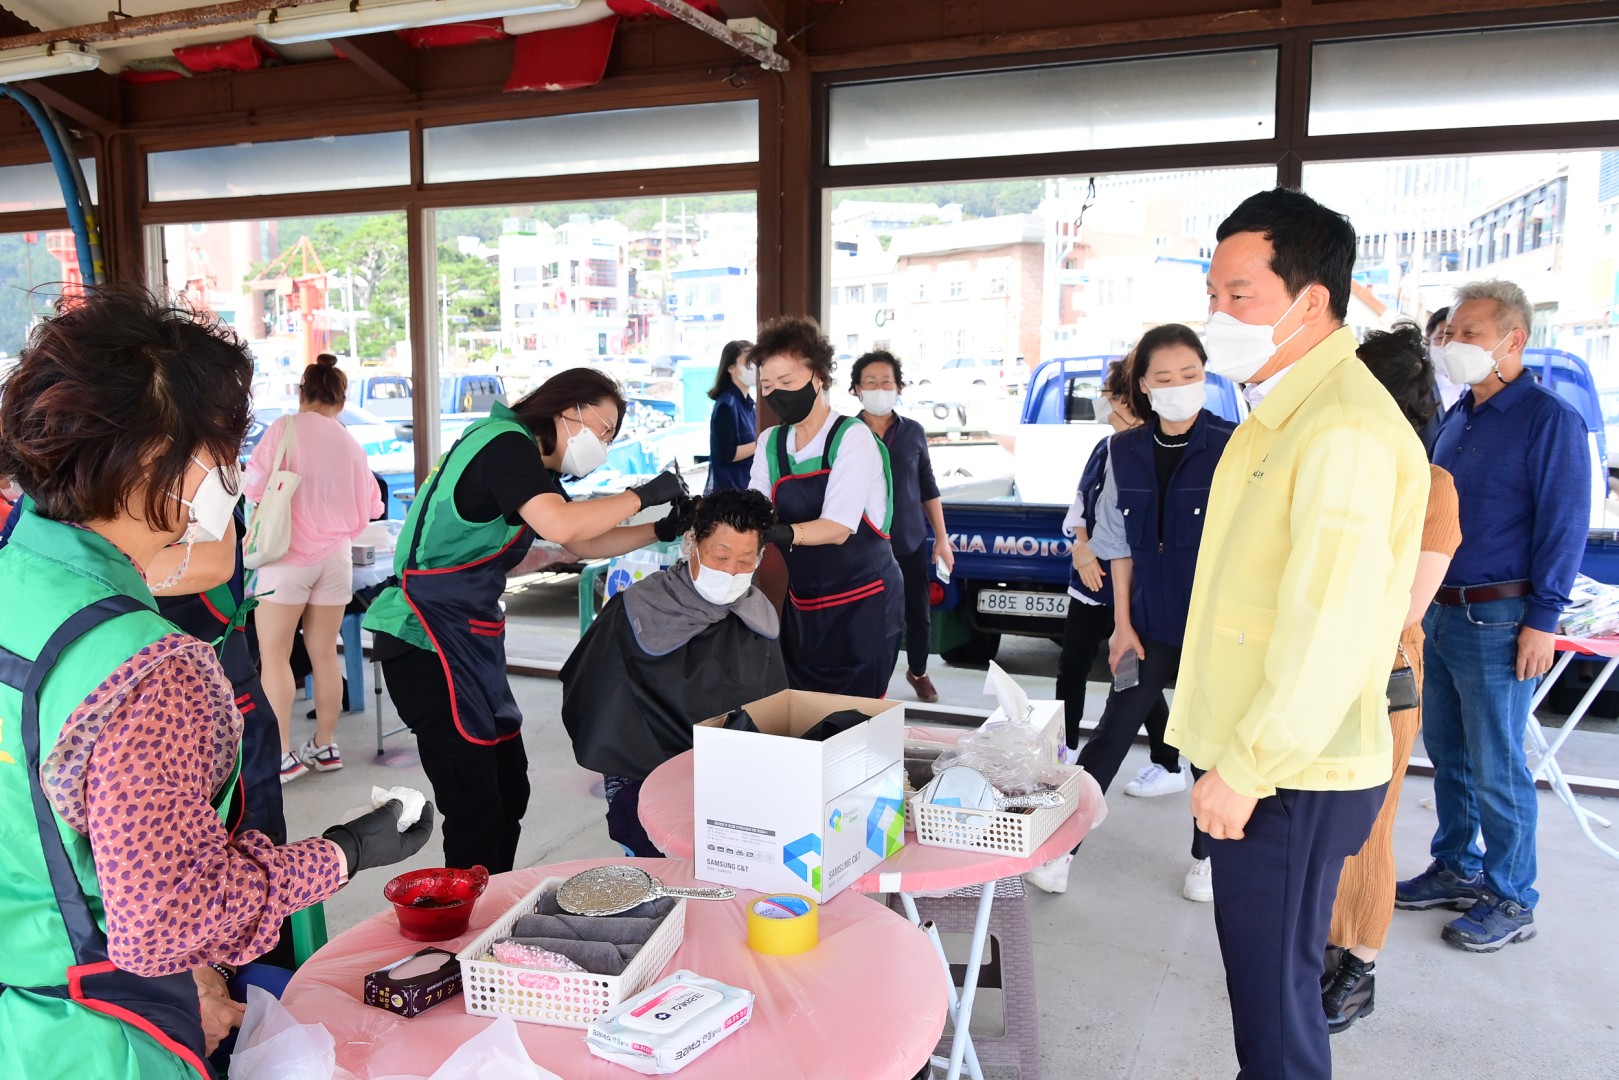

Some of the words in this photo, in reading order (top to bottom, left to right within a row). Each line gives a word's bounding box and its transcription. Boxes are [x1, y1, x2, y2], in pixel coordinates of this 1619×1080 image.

[945, 533, 987, 553] KIA
[993, 535, 1077, 557] MOTO
[988, 594, 1017, 610] 88도
[1025, 596, 1065, 613] 8536
[706, 858, 736, 871] SAMSUNG
[736, 864, 749, 873] C&T
[828, 857, 852, 880] SAMSUNG
[851, 851, 861, 865] C&T
